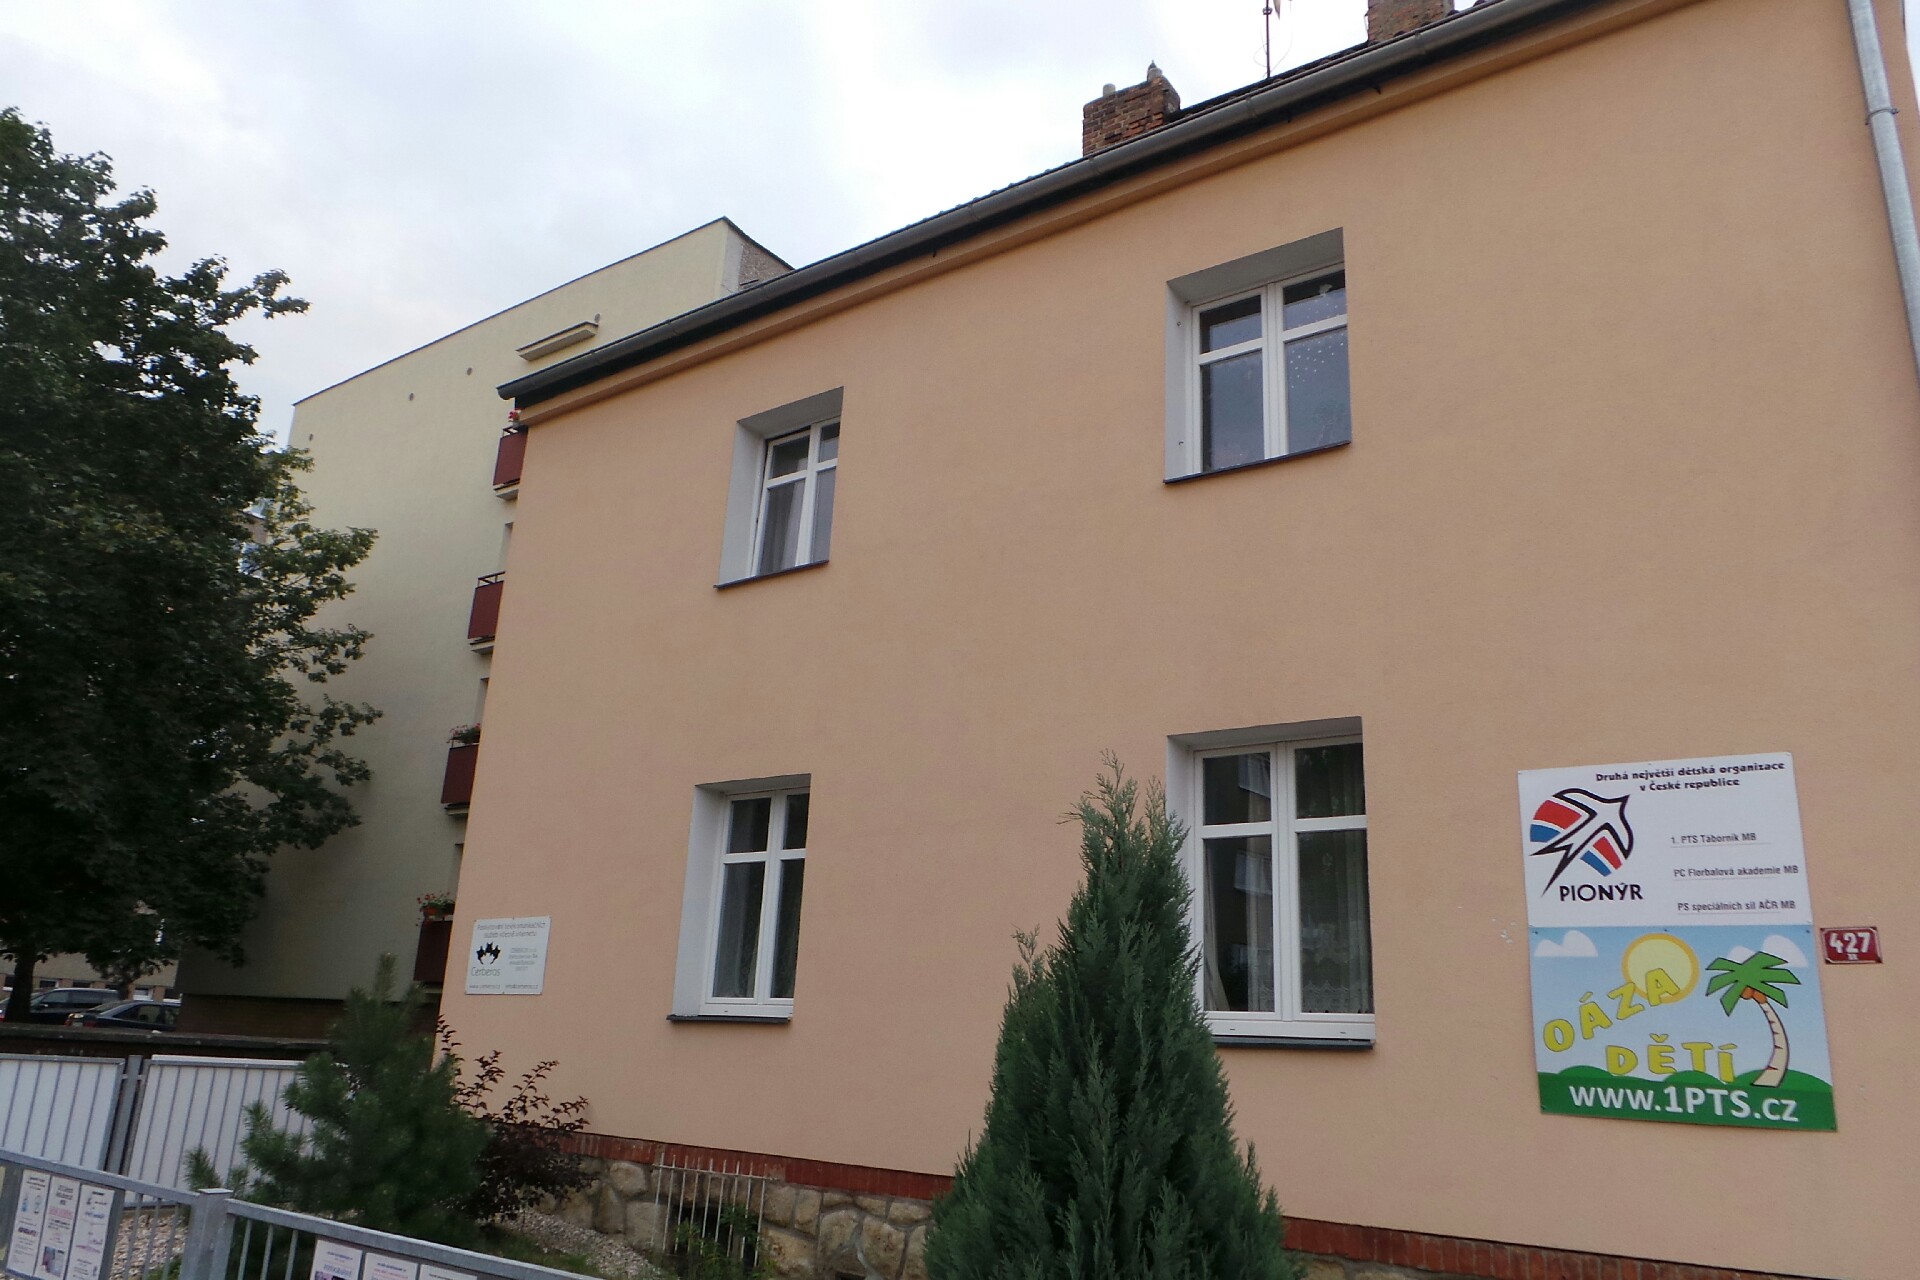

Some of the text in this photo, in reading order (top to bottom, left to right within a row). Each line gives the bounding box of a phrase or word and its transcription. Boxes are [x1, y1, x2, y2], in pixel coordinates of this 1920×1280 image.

[1596, 762, 1785, 781] Druhá největší dětská organizace
[1649, 780, 1680, 791] České
[1684, 778, 1740, 790] republice
[1681, 834, 1699, 844] PTS
[1741, 832, 1757, 841] MB
[1673, 865, 1799, 877] PC Florbalová akademie MB
[1559, 882, 1644, 902] PIONÝR
[1677, 902, 1689, 911] PS
[1758, 899, 1778, 910] AČR
[1780, 900, 1796, 909] MB
[1830, 932, 1870, 953] 427
[1543, 967, 1681, 1052] OÁZA
[1606, 1033, 1738, 1082] DĚTÍ
